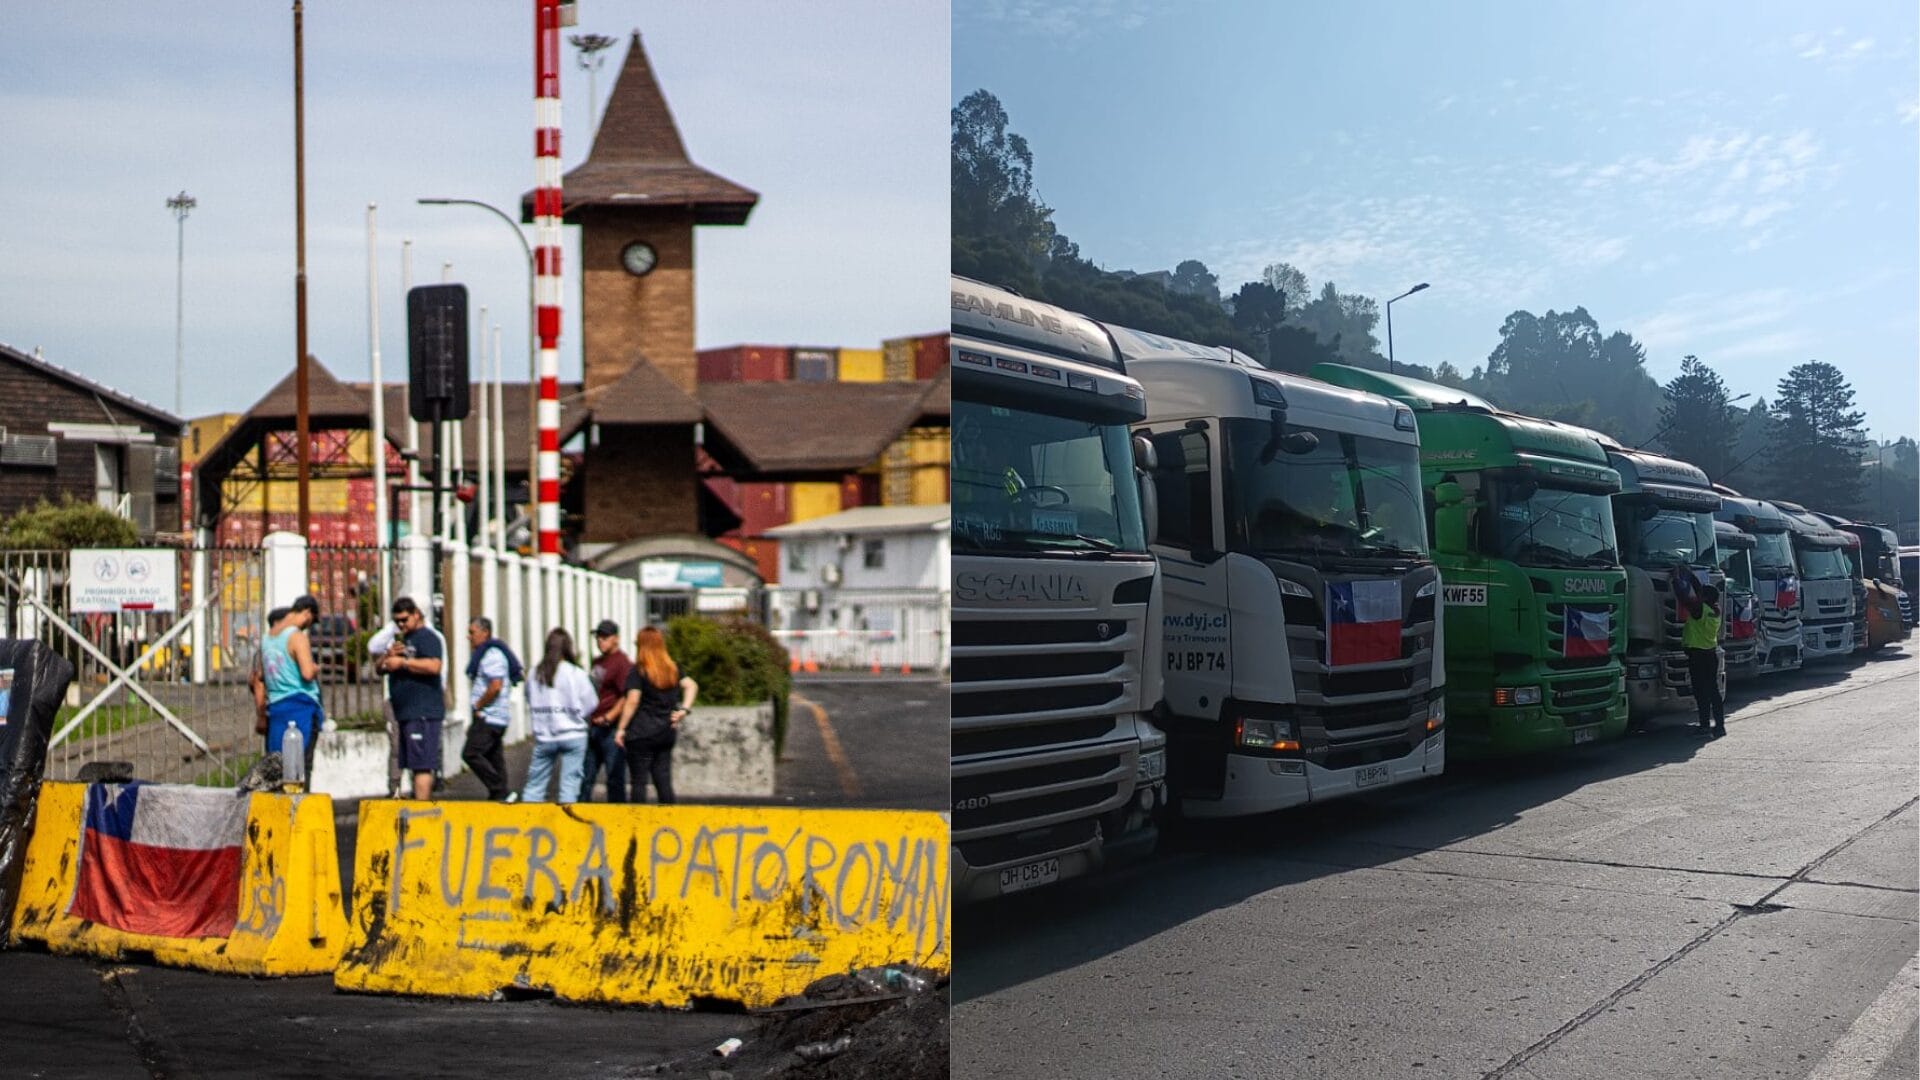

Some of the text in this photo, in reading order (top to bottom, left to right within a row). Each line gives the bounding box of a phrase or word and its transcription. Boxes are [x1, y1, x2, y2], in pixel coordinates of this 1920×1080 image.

[956, 571, 1090, 601] SCANIA
[1564, 577, 1607, 593] SCANIA
[1167, 652, 1225, 671] PJ BP 74
[956, 796, 989, 810] 480
[391, 808, 616, 913] FUERA
[1001, 869, 1018, 886] JH
